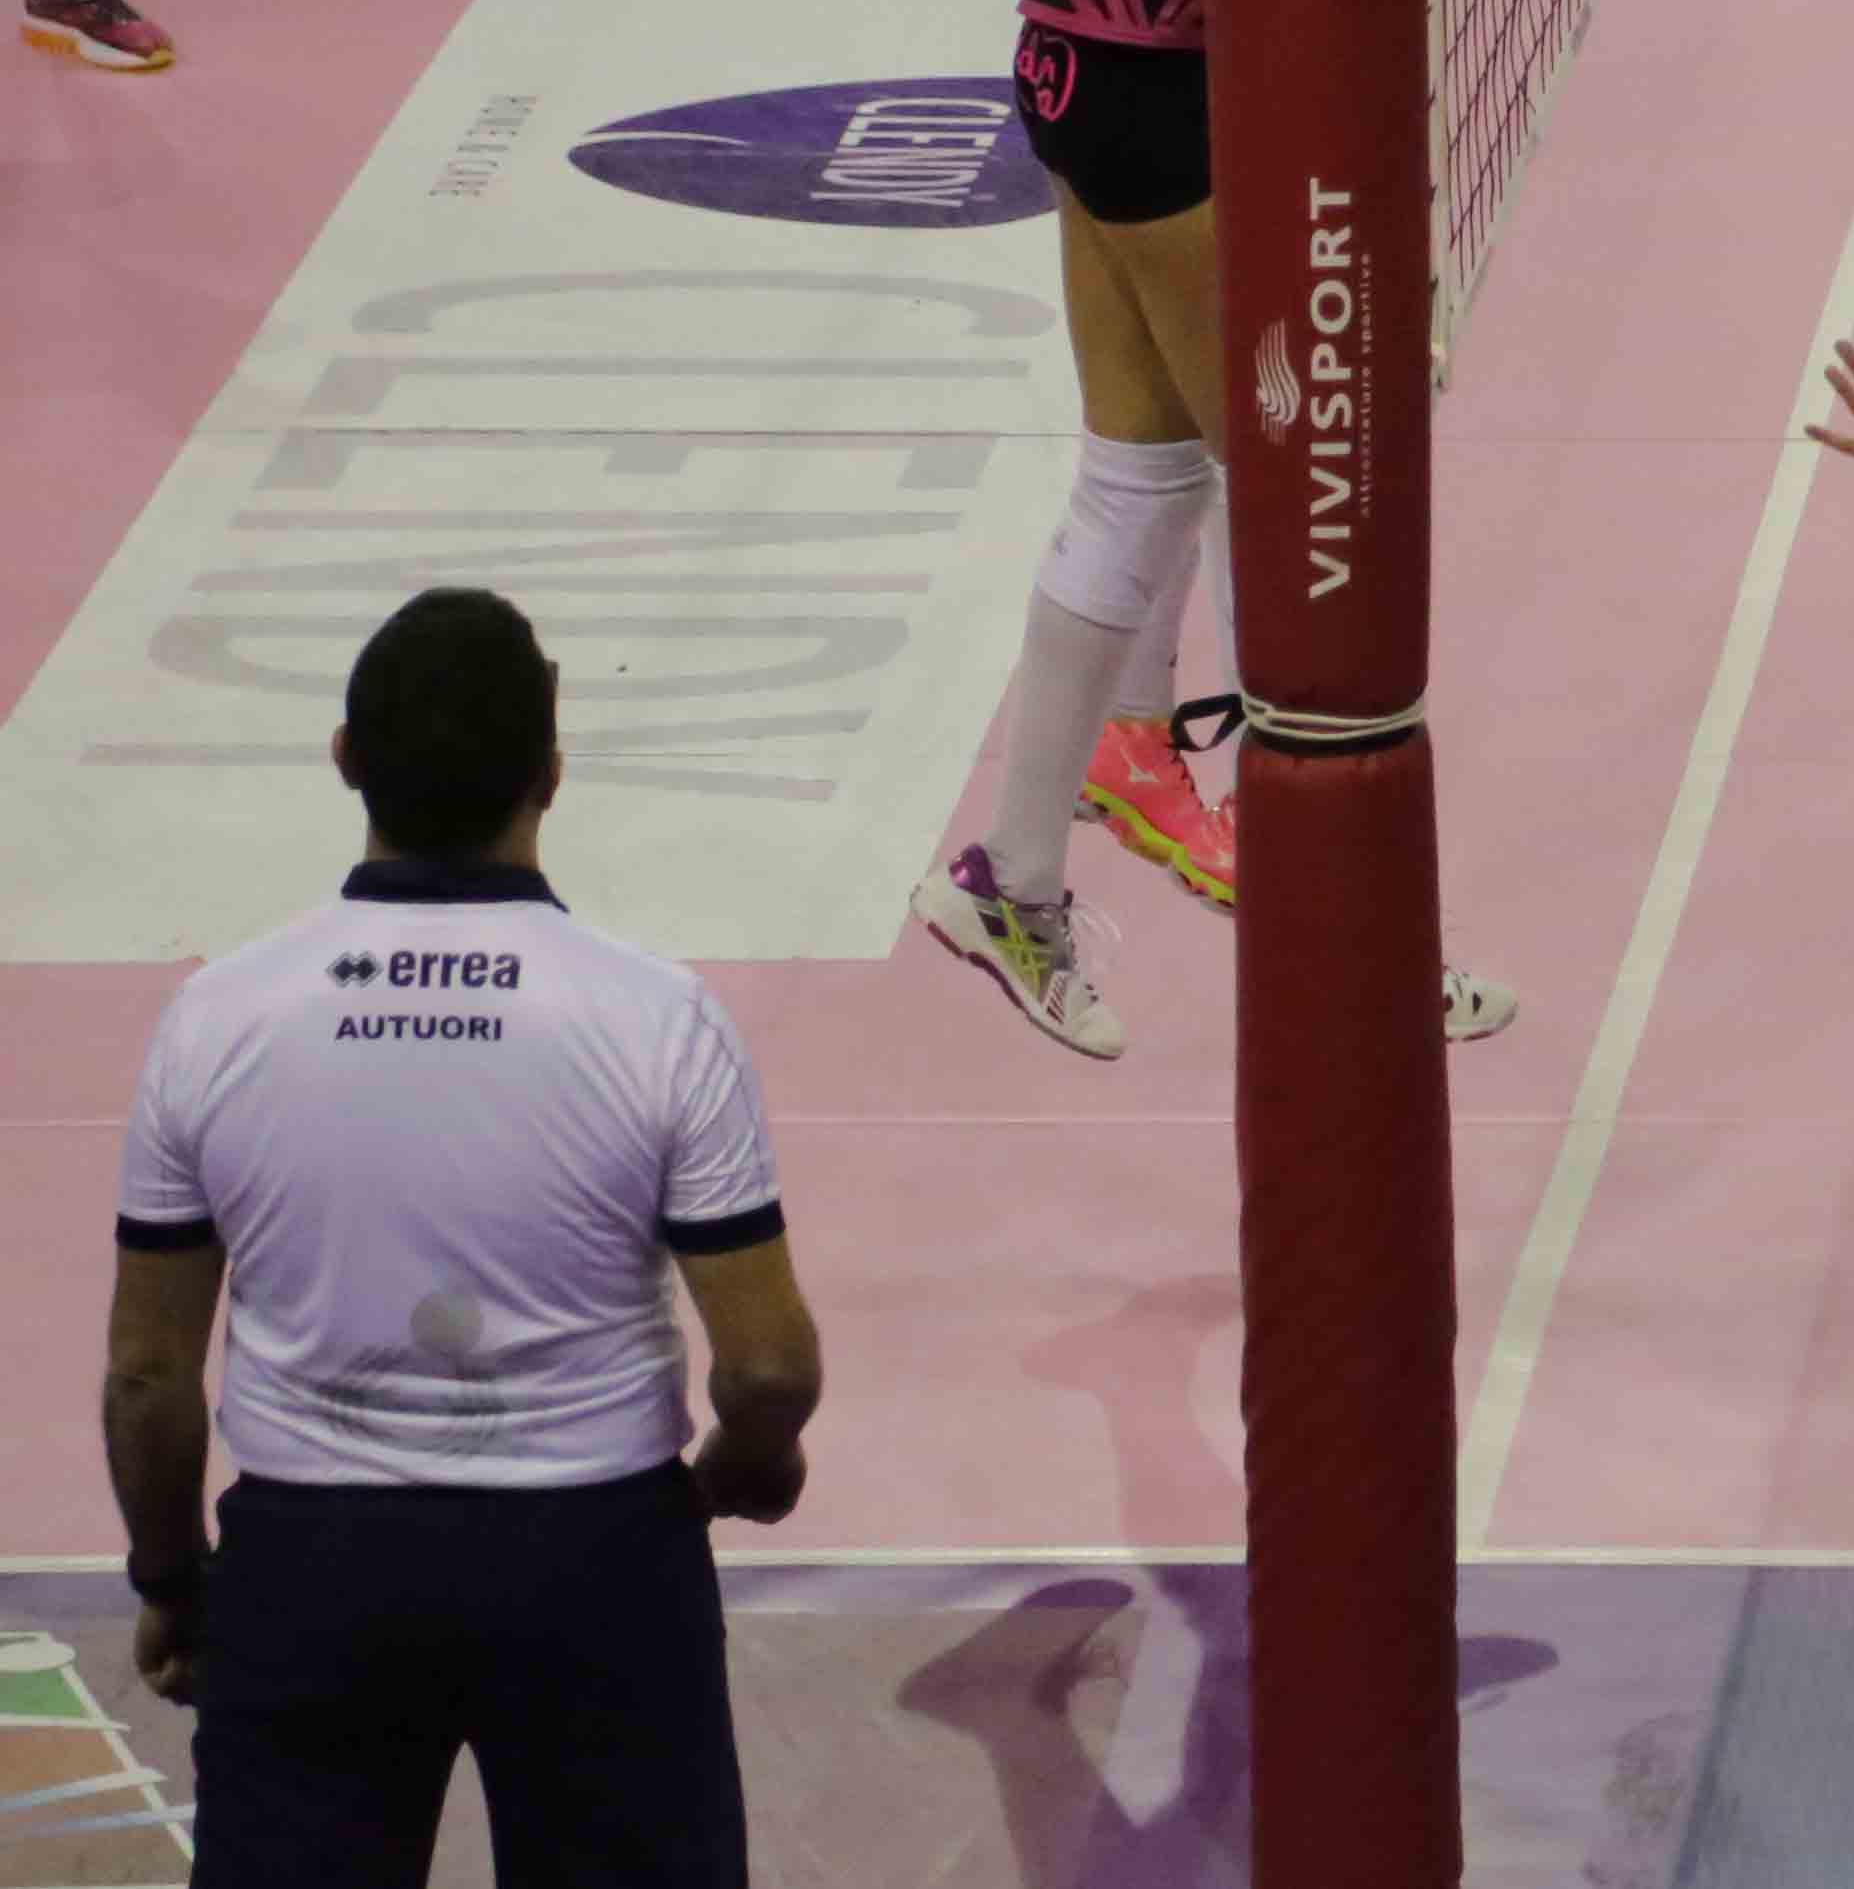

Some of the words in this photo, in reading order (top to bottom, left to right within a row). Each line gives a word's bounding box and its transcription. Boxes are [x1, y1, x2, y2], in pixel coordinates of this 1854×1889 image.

[810, 97, 1012, 208] CLENDY
[1308, 176, 1353, 599] VIVISPORT
[387, 951, 521, 990] errea
[333, 1014, 503, 1042] AUTUORI
